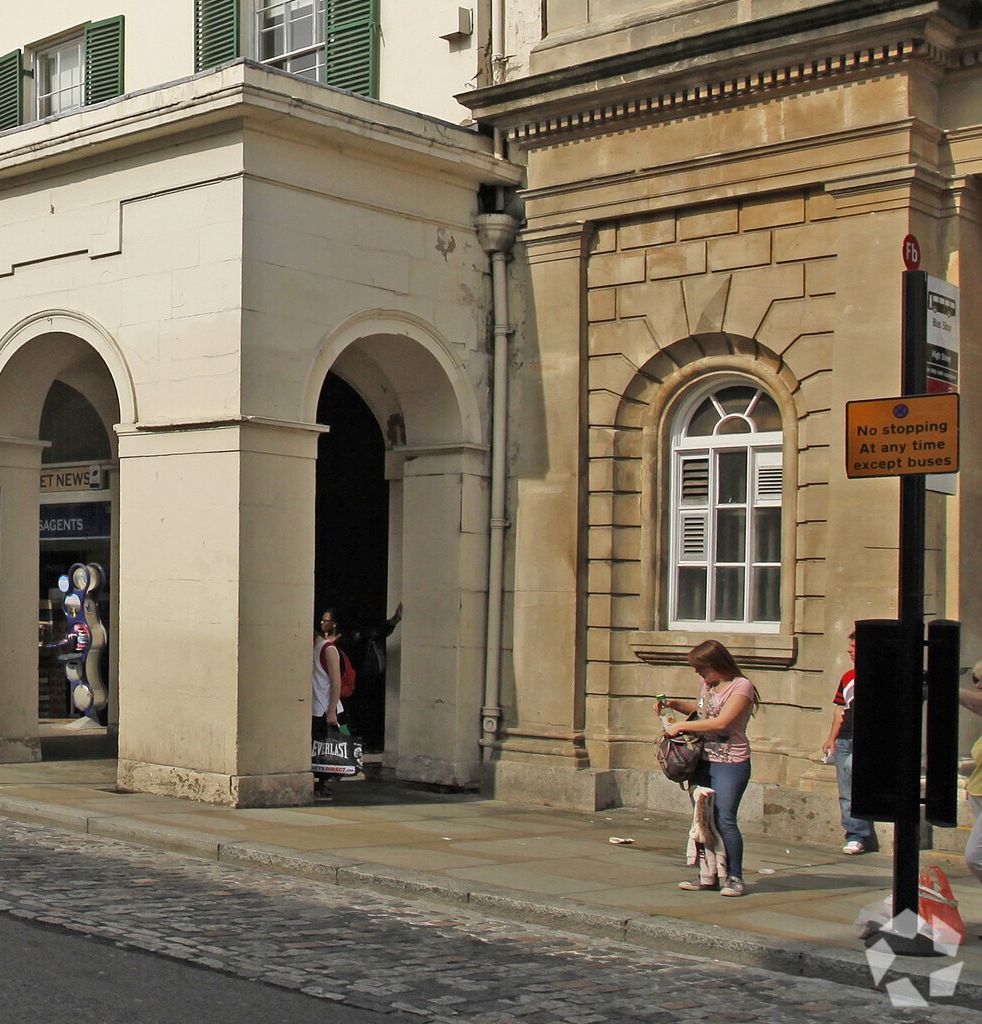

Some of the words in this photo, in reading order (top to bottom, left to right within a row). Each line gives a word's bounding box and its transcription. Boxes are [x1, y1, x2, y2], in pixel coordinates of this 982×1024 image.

[906, 241, 918, 263] Fb
[932, 317, 942, 329] Bus
[857, 426, 877, 436] No
[883, 421, 948, 435] stopping
[859, 442, 877, 454] At
[881, 443, 906, 454] any
[912, 440, 946, 451] time
[853, 457, 903, 471] except
[907, 456, 952, 468] buses
[56, 472, 90, 487] NEWS
[312, 740, 349, 759] EVERLAST
